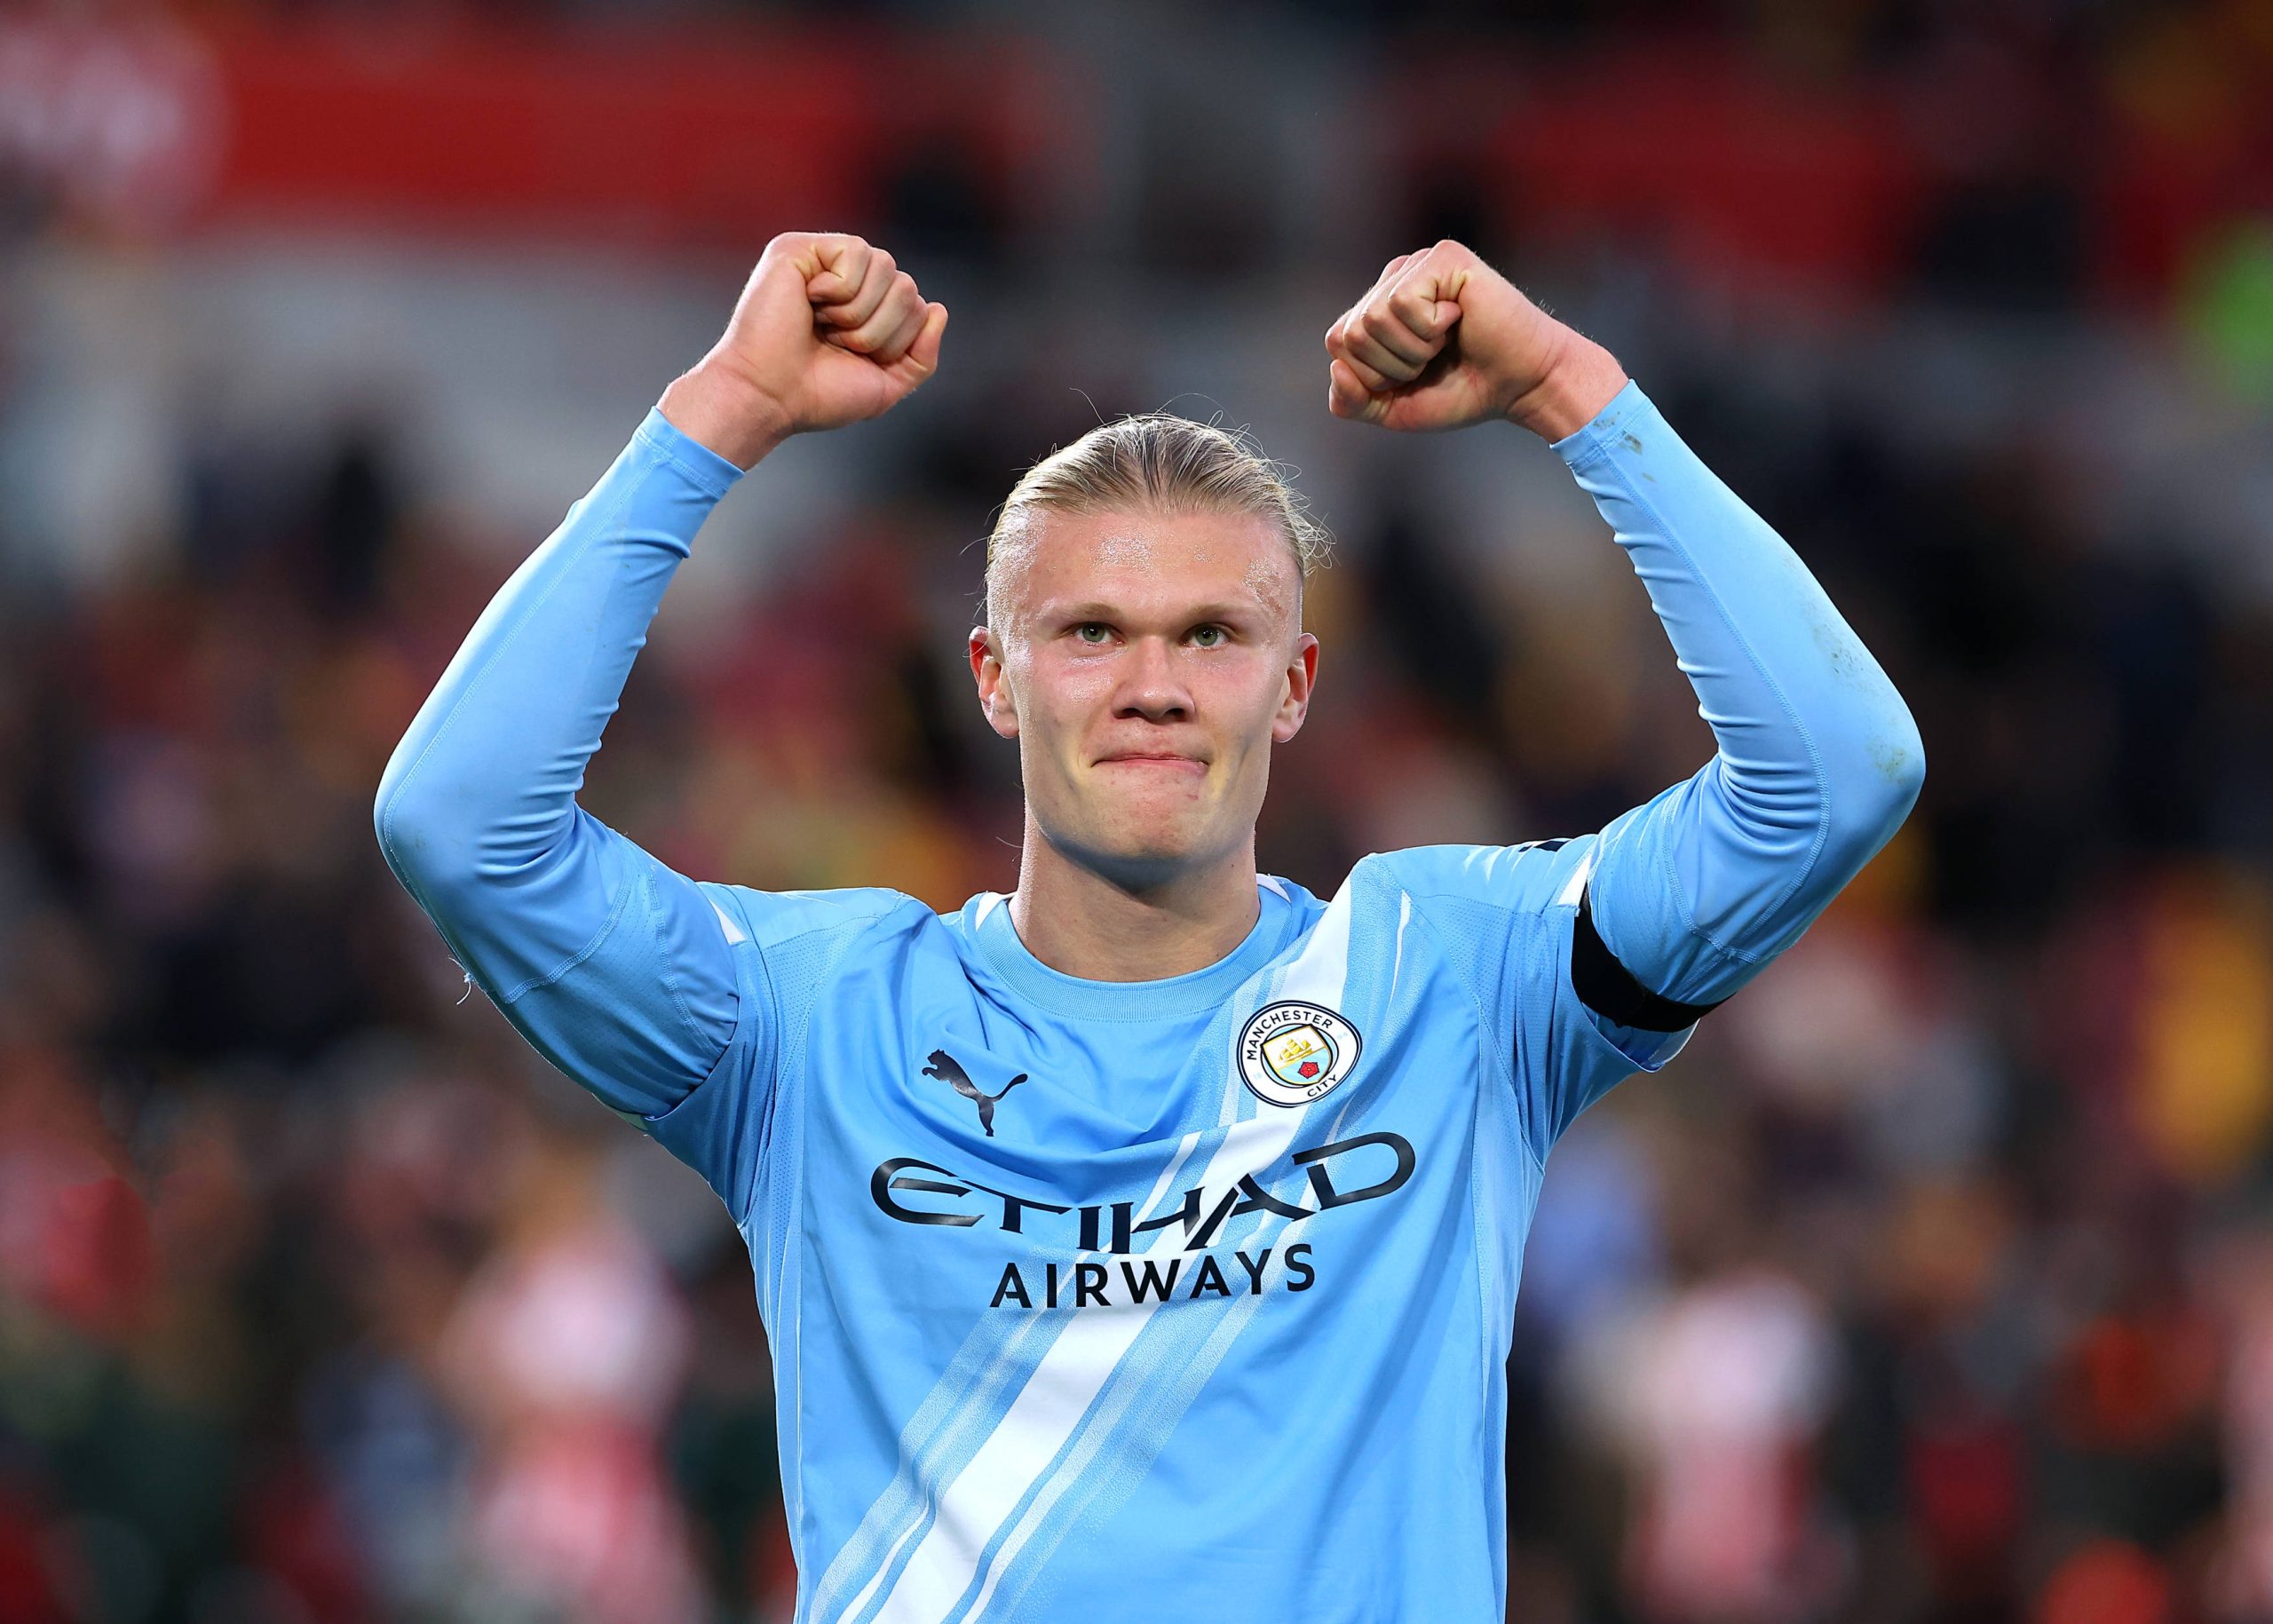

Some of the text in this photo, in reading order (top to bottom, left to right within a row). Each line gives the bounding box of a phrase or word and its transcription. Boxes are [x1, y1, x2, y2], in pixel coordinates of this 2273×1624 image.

[1247, 1010, 1333, 1060] MANCHESTER
[1307, 1074, 1336, 1097] CITY
[870, 1131, 1415, 1254] ETIHAD
[990, 1244, 1316, 1309] AIRWAYS
